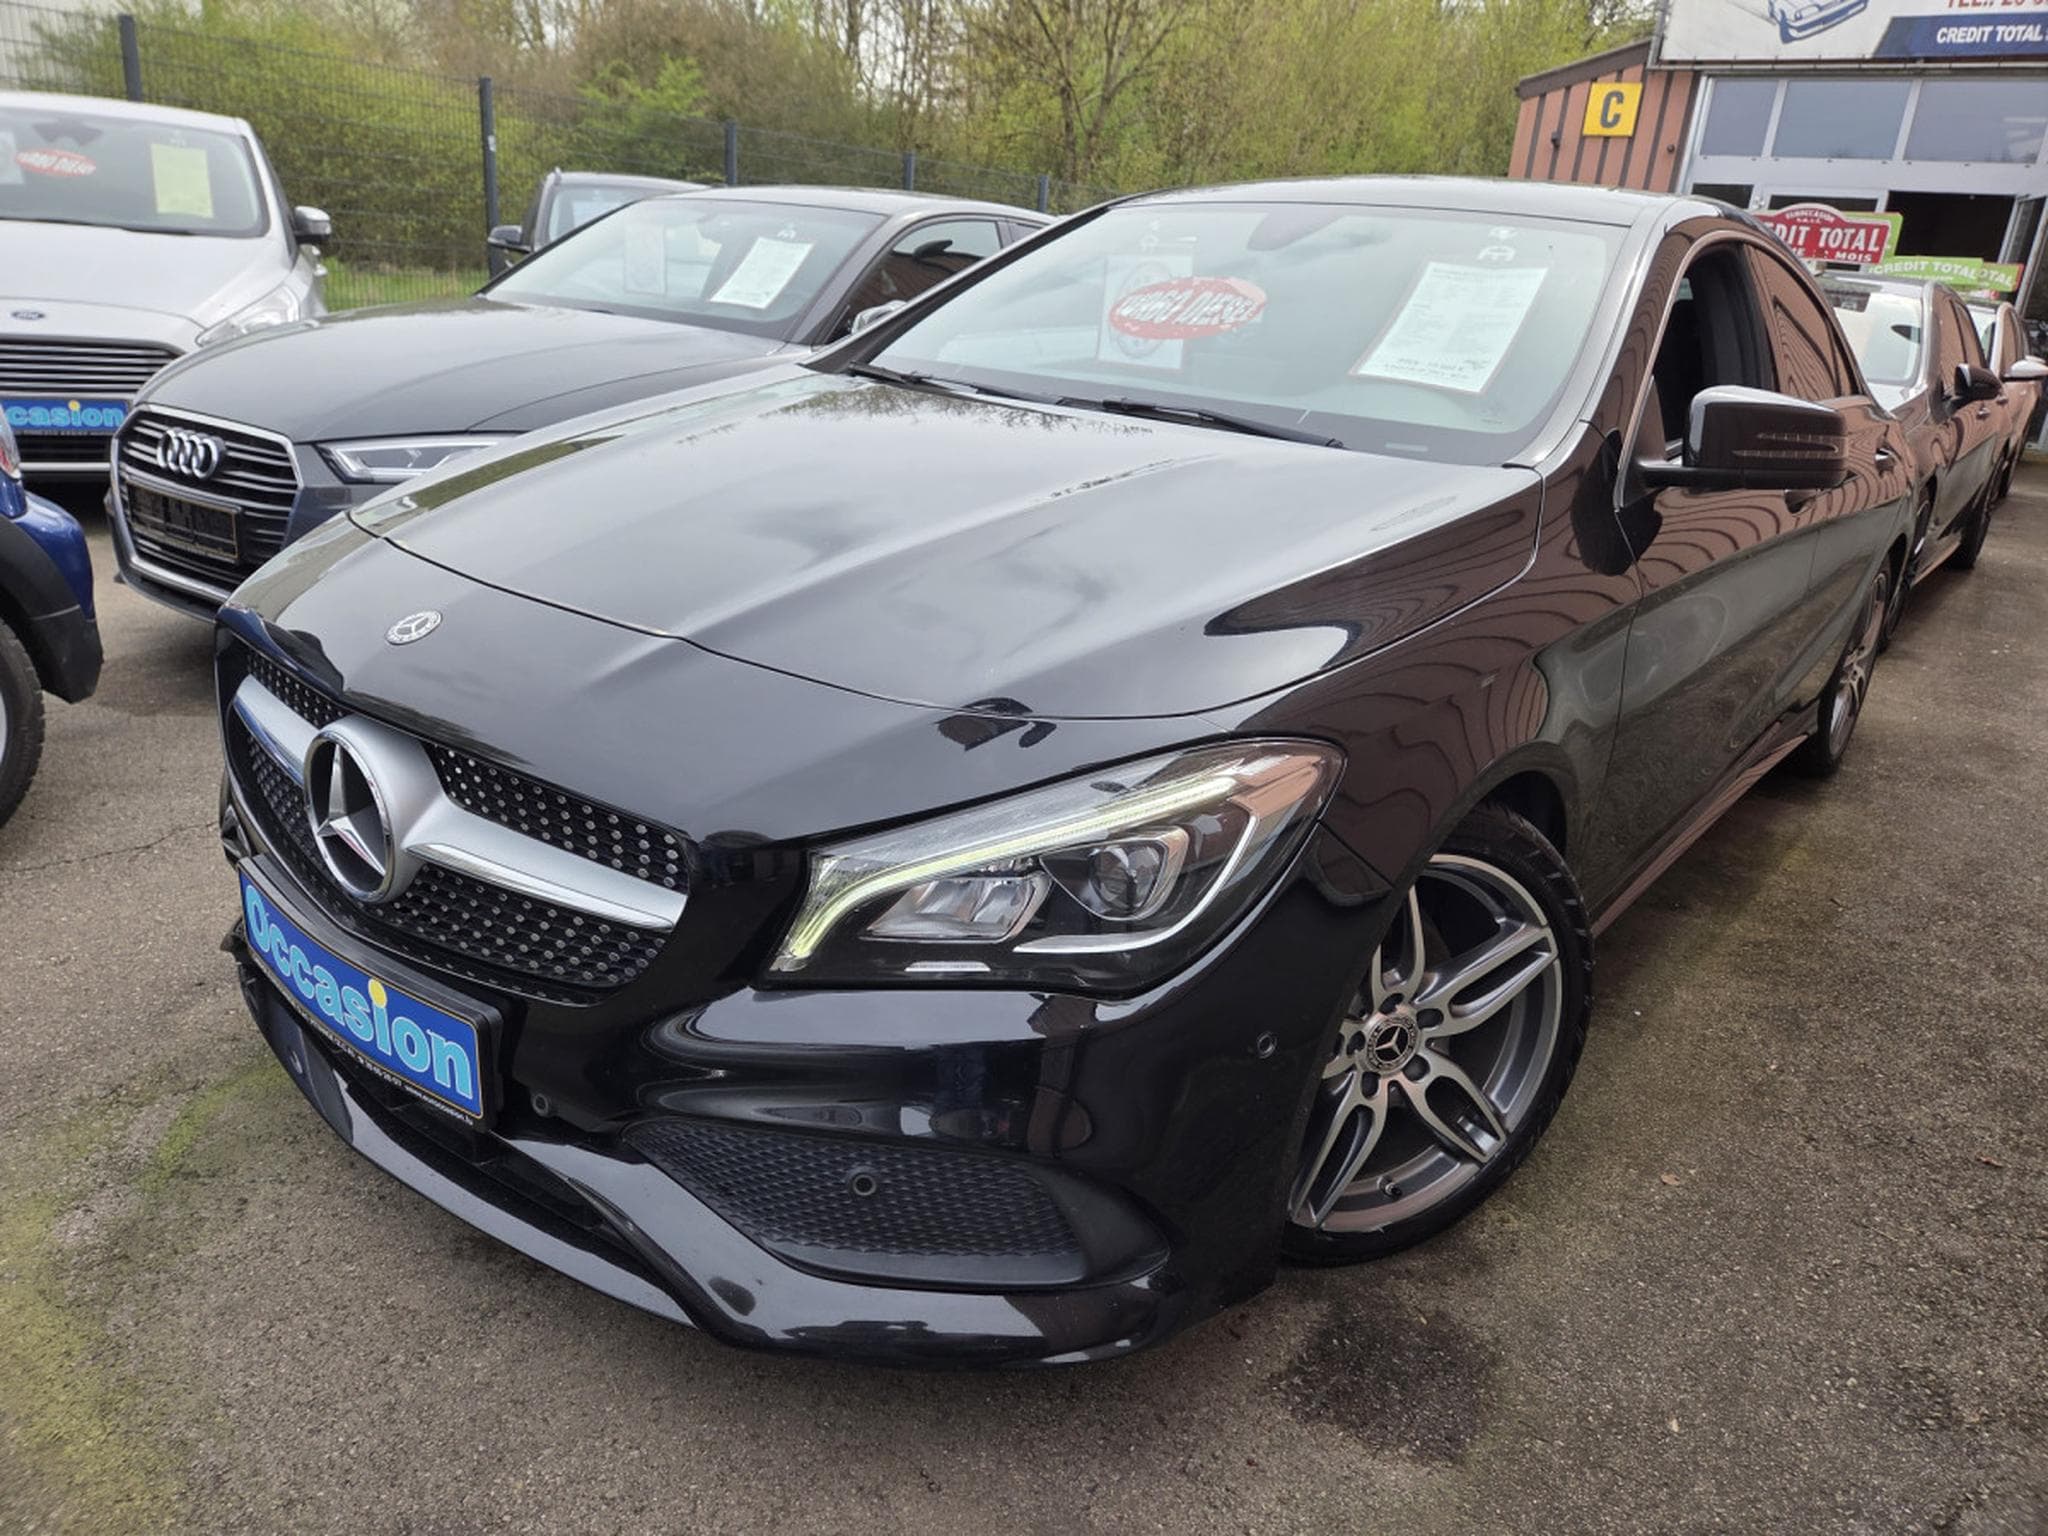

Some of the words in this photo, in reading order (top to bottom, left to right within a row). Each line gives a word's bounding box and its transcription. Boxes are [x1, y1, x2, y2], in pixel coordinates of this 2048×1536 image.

[1936, 26, 1994, 44] CREDIT
[1995, 24, 2043, 42] TOTAL
[1600, 91, 1624, 128] C
[1818, 226, 1880, 252] TOTAL
[1835, 250, 1872, 263] MOIS
[1979, 267, 2014, 289] OTAL
[5, 399, 125, 428] casion
[245, 884, 473, 1100] Occasion
